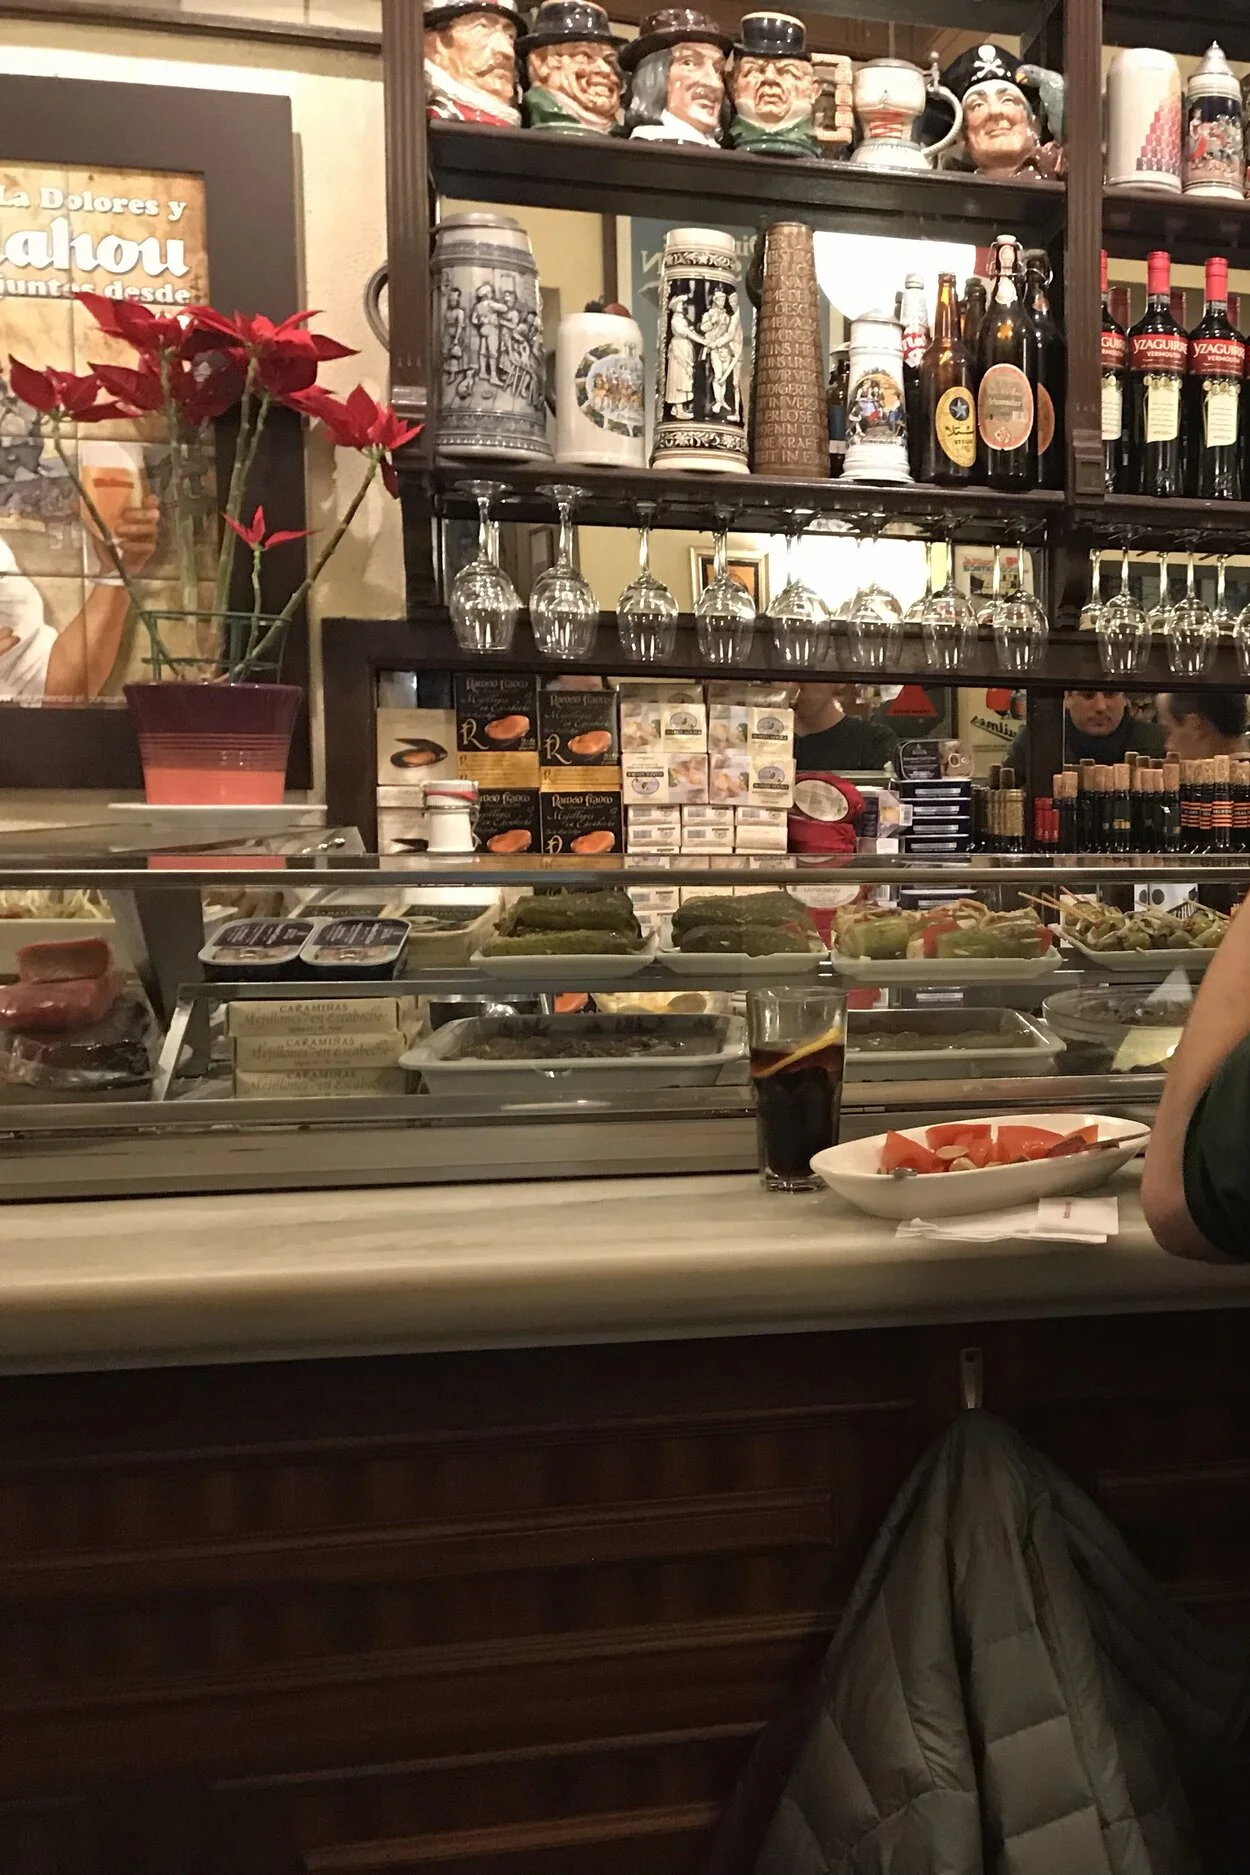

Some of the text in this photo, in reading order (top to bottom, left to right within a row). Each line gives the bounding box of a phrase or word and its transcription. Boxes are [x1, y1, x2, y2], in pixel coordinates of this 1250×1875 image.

[39, 187, 160, 216] Dolores
[168, 200, 187, 222] y
[0, 216, 190, 277] ahou
[104, 280, 192, 304] desde
